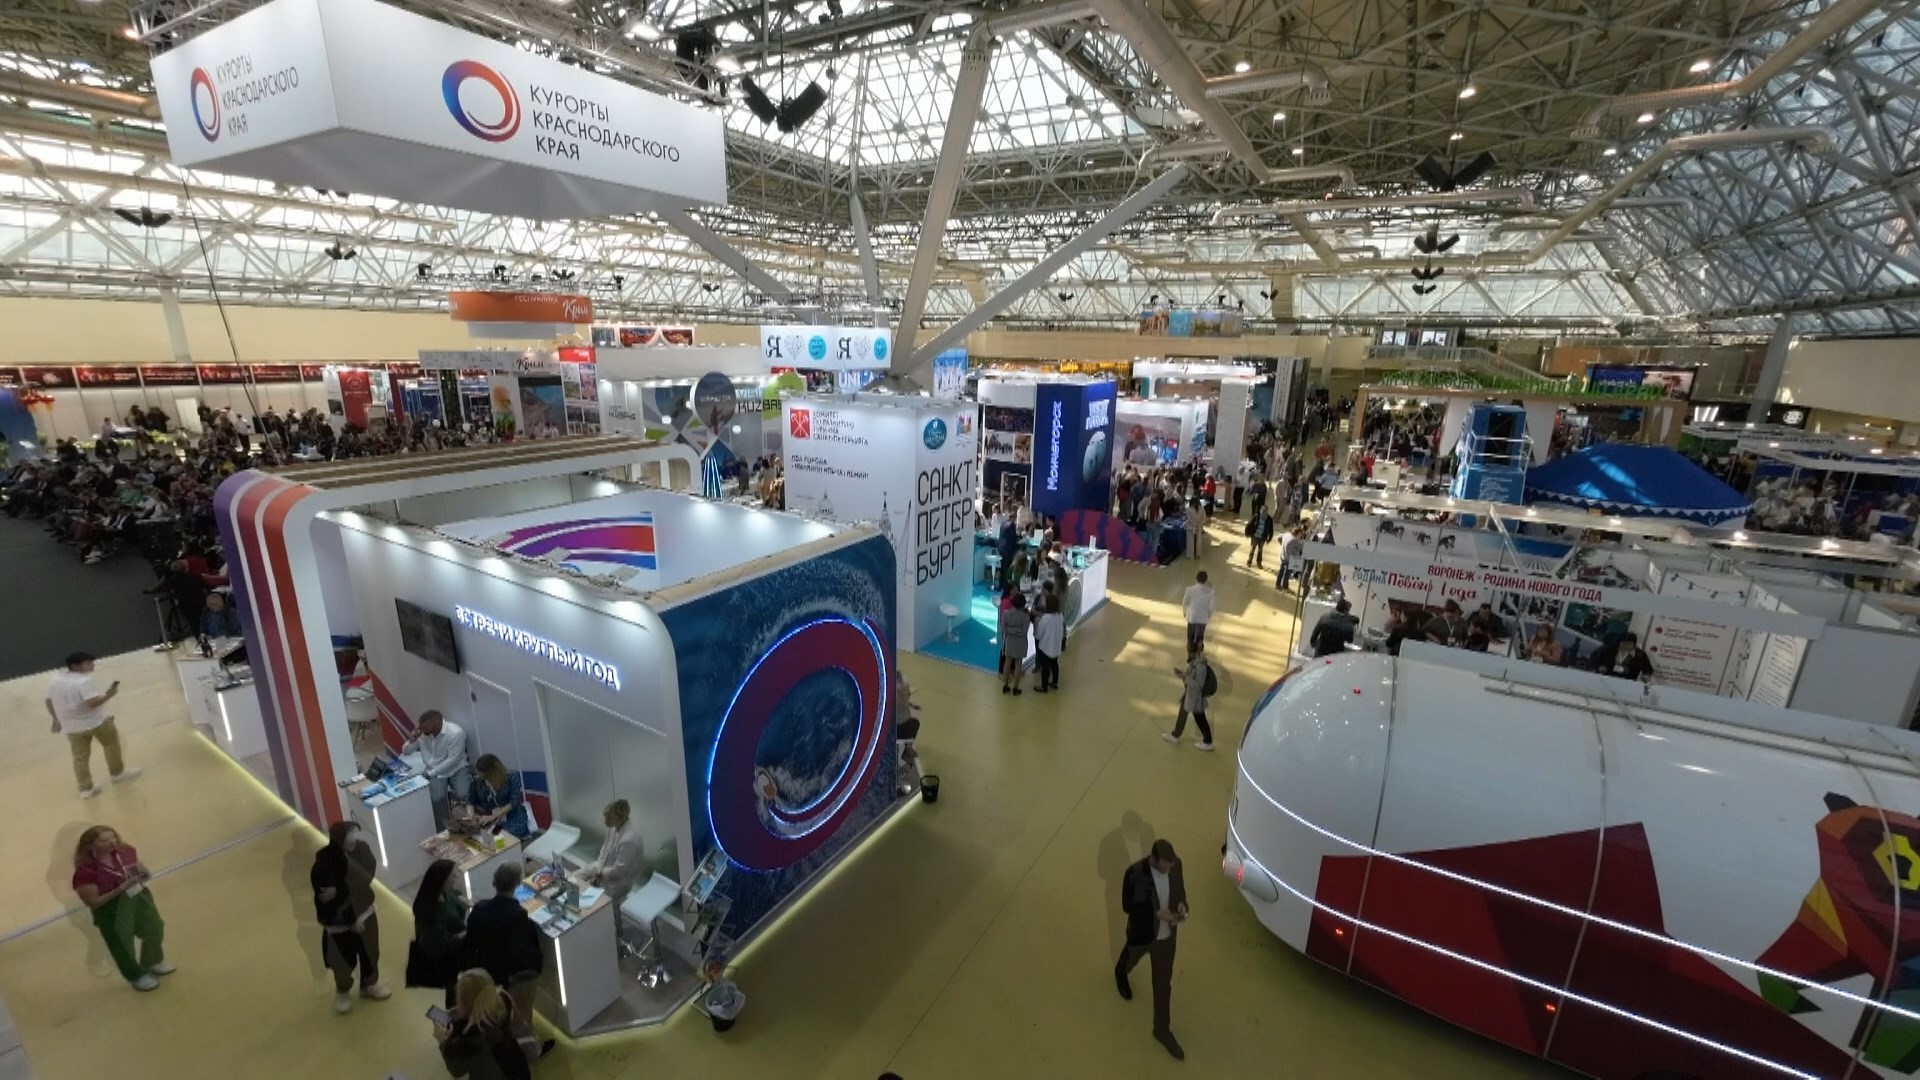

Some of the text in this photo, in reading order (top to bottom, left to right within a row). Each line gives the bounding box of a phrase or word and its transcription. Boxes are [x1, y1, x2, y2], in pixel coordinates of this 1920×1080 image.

[216, 53, 253, 84] КУРОРТЫ
[222, 66, 299, 111] КРАСНОДАРСКОГО
[227, 113, 249, 137] КРАЯ
[530, 84, 609, 123] КУРОРТЫ
[533, 109, 680, 162] КРАСНОДАРСКОГО
[536, 135, 580, 161] КРАЯ
[917, 459, 973, 506] САНКТ
[917, 497, 973, 547] ПЕТЕР
[917, 537, 962, 586] БУРГ
[1428, 564, 1476, 582] ВОРОНЕЖ
[1483, 573, 1527, 591] РОДИНА
[1528, 579, 1570, 596] НОВОГО
[1572, 586, 1602, 602] ГОДА
[514, 628, 584, 673] КРУГЛЫЙ
[584, 656, 621, 692] ГОД
